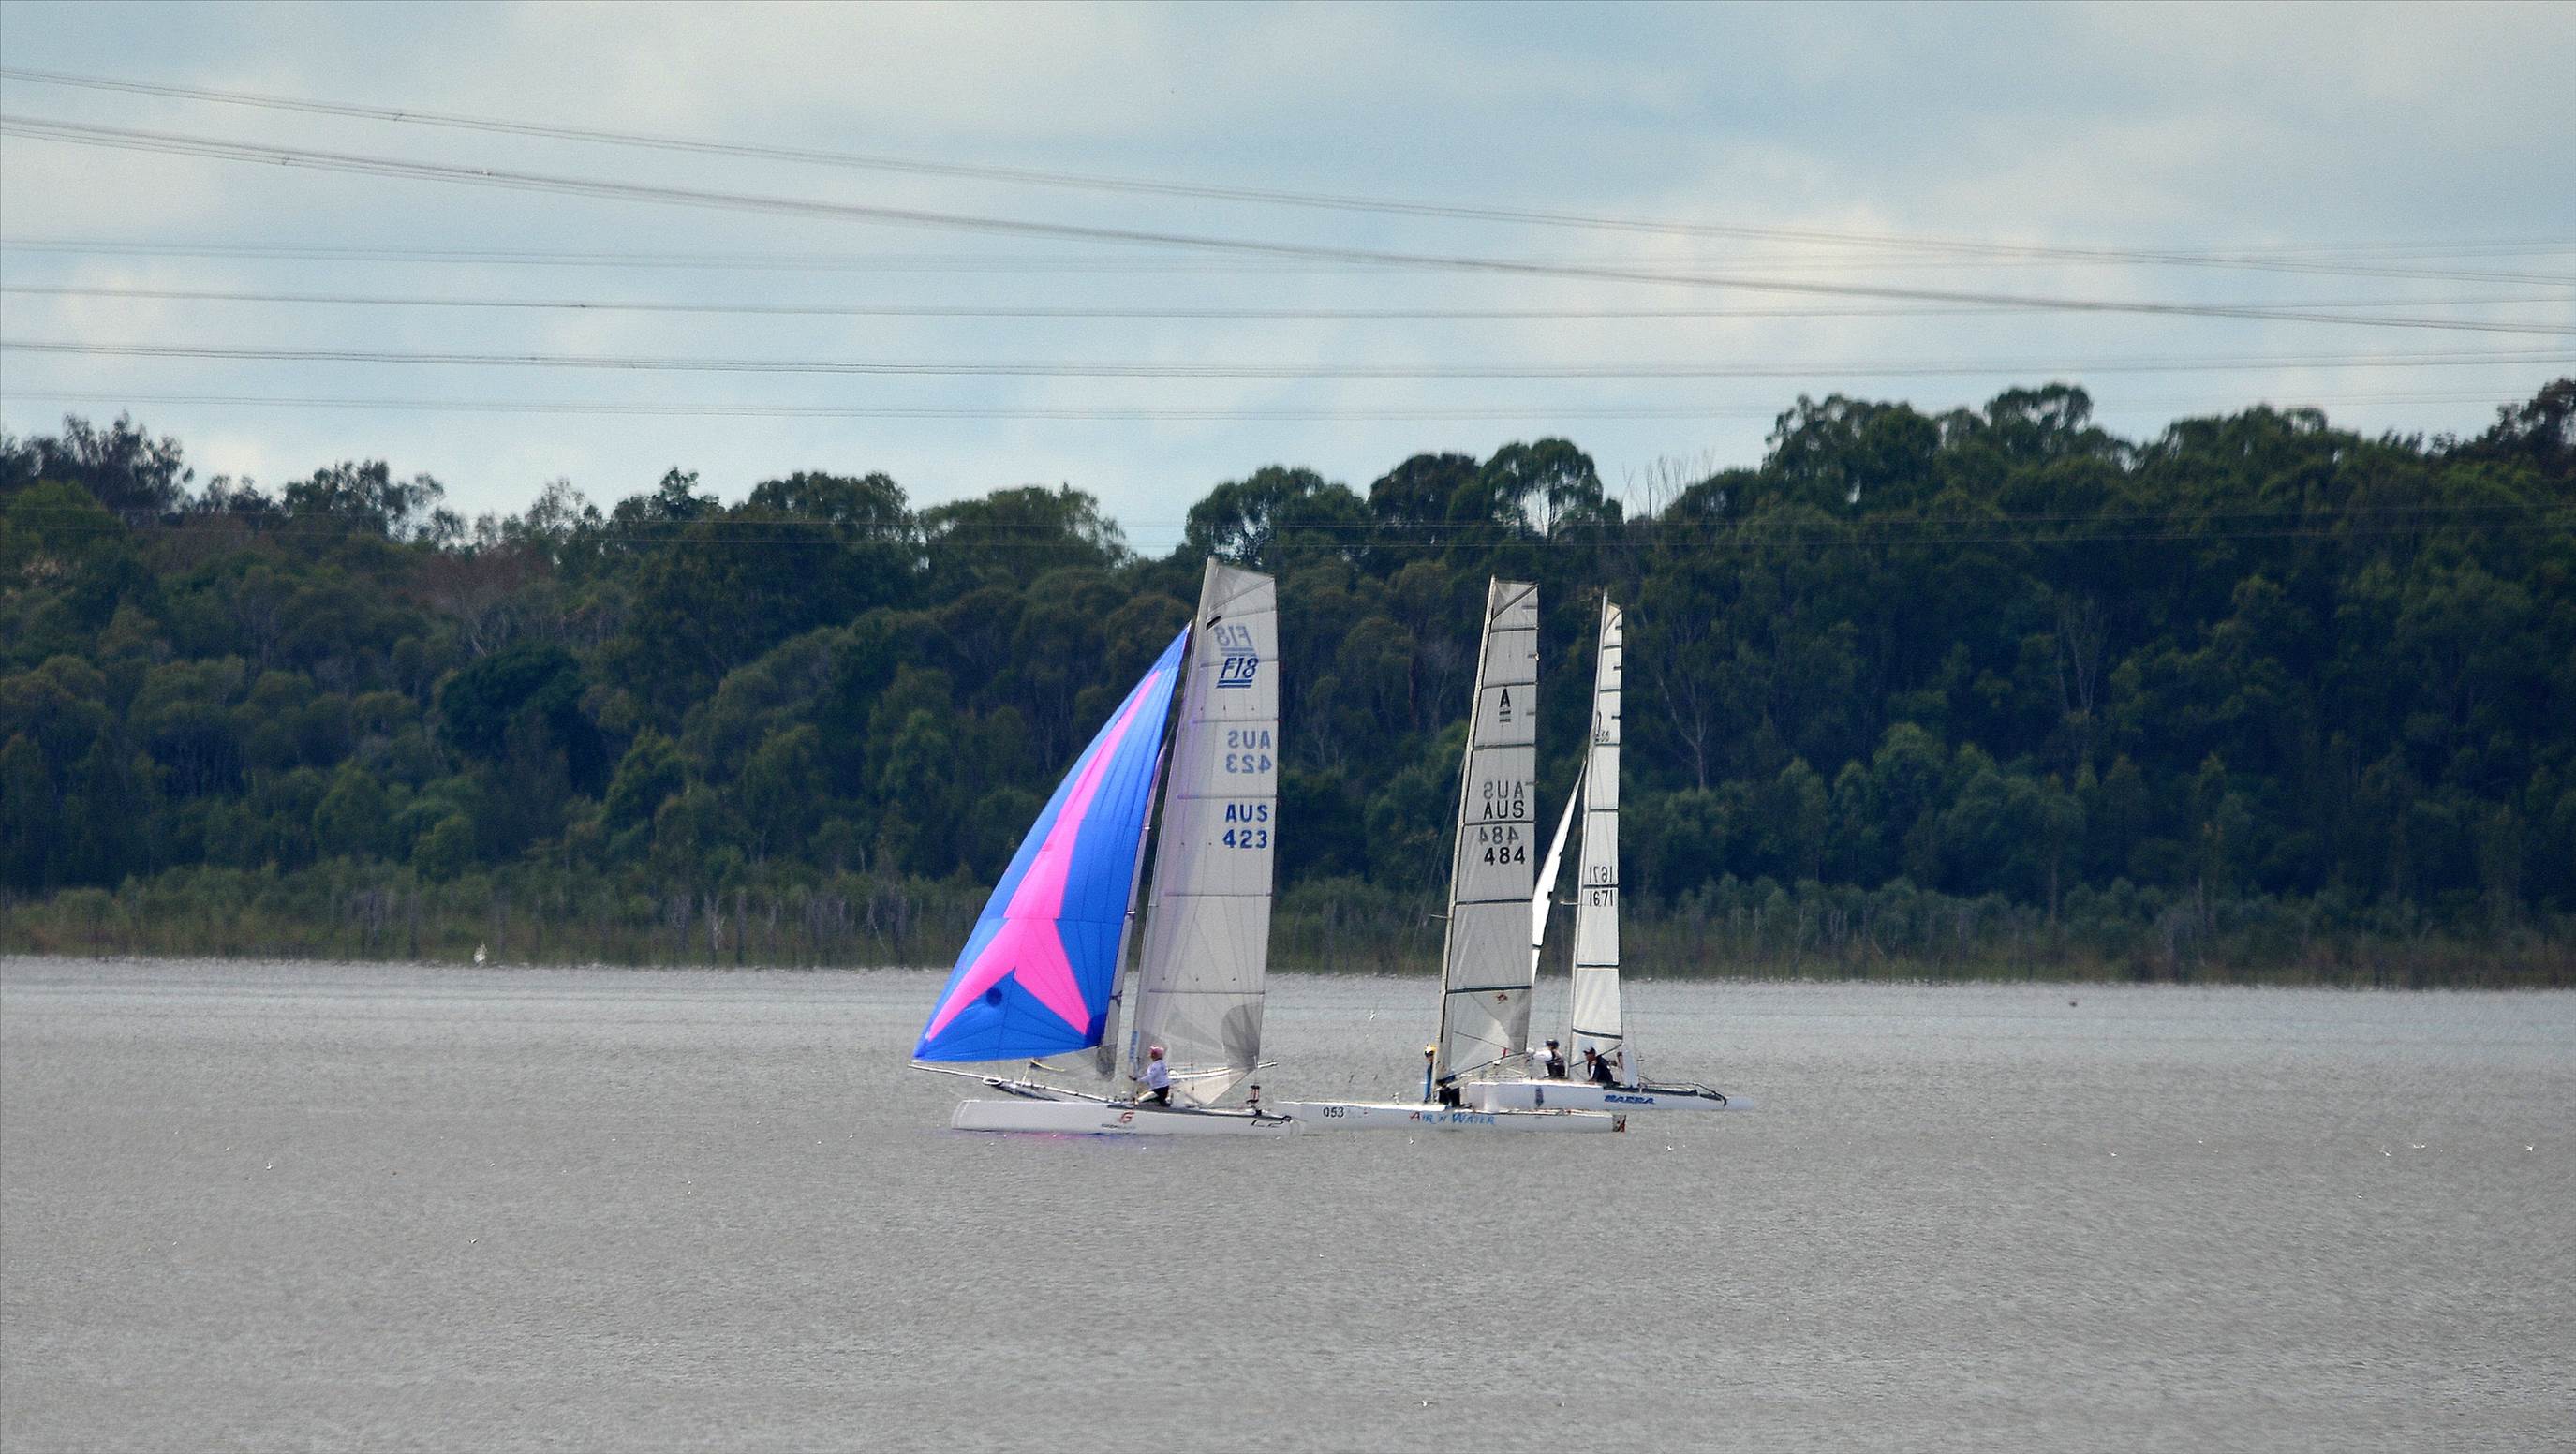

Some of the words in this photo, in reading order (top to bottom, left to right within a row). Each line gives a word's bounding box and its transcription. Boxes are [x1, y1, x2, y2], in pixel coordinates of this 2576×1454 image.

[1221, 657, 1259, 678] F18
[1500, 688, 1511, 707] A
[1225, 804, 1268, 823] AUS
[1483, 800, 1524, 820] AUS
[1222, 828, 1267, 849] 423
[1484, 845, 1525, 866] 484
[1590, 889, 1613, 907] 1671
[1323, 1106, 1345, 1119] 053
